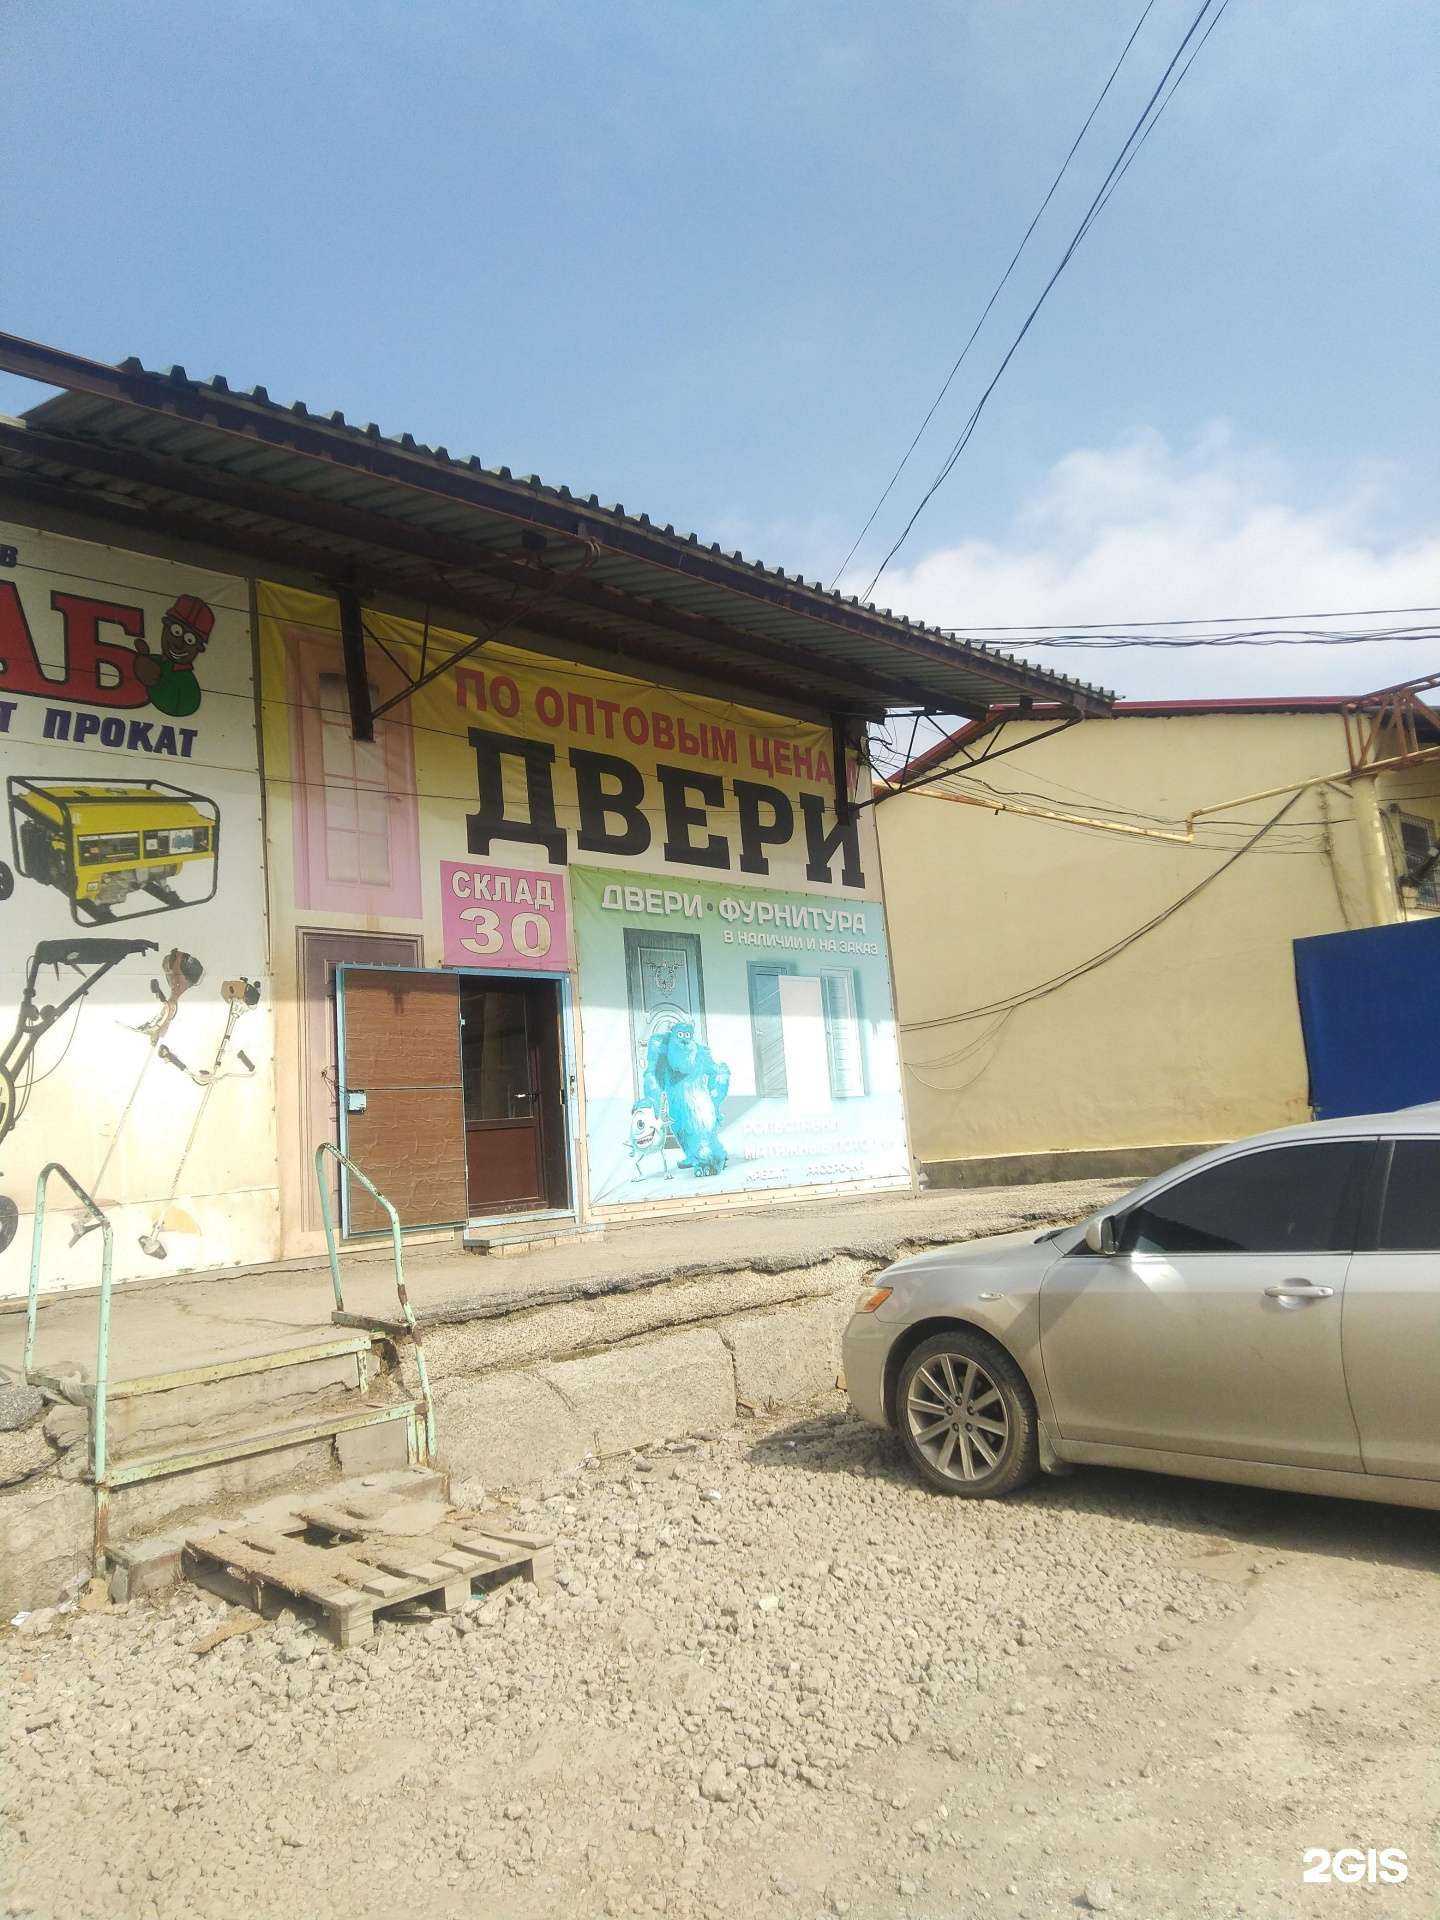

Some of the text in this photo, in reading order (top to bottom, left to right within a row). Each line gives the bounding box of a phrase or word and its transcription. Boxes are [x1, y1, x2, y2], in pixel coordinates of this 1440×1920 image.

[43, 707, 198, 757] ПРОКАТ
[455, 666, 520, 718] ПО
[535, 686, 738, 765] ОПТОВЫМ
[466, 726, 865, 889] ДВЕРИ
[451, 870, 555, 911] СКЛАД
[602, 884, 866, 935] ДВЕРИ ФУРНИТУРА
[459, 907, 552, 959] 30
[723, 930, 879, 955] В НАЛИЧИИ И НА ЗАКАЗ
